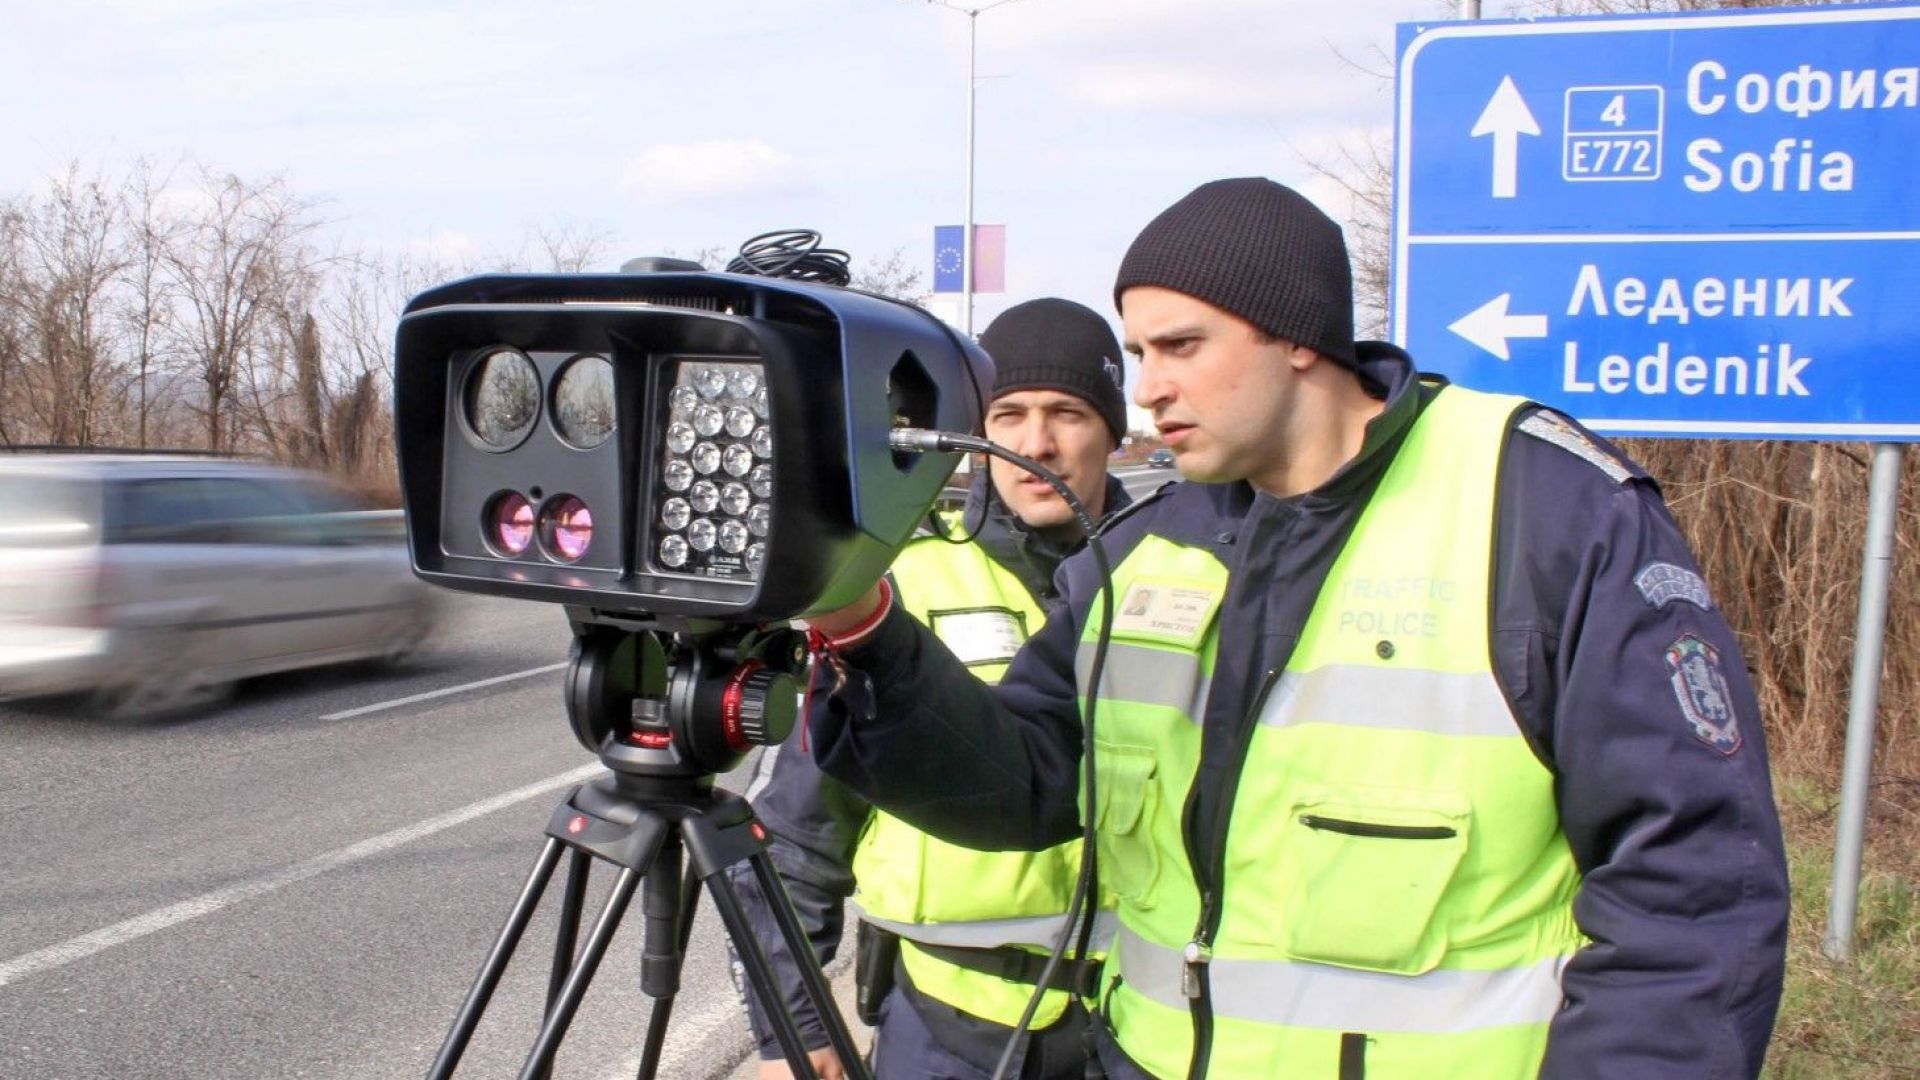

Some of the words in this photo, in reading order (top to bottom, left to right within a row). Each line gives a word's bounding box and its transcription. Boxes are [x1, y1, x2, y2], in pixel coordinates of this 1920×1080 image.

[1600, 94, 1627, 127] 4
[1687, 61, 1918, 117] София
[1571, 140, 1652, 174] E772
[1684, 138, 1855, 193] Sofia
[1566, 264, 1856, 326] Леденик
[1562, 341, 1814, 397] Ledenik
[1342, 577, 1456, 602] TRAFFIC
[1339, 610, 1438, 637] POLICE
